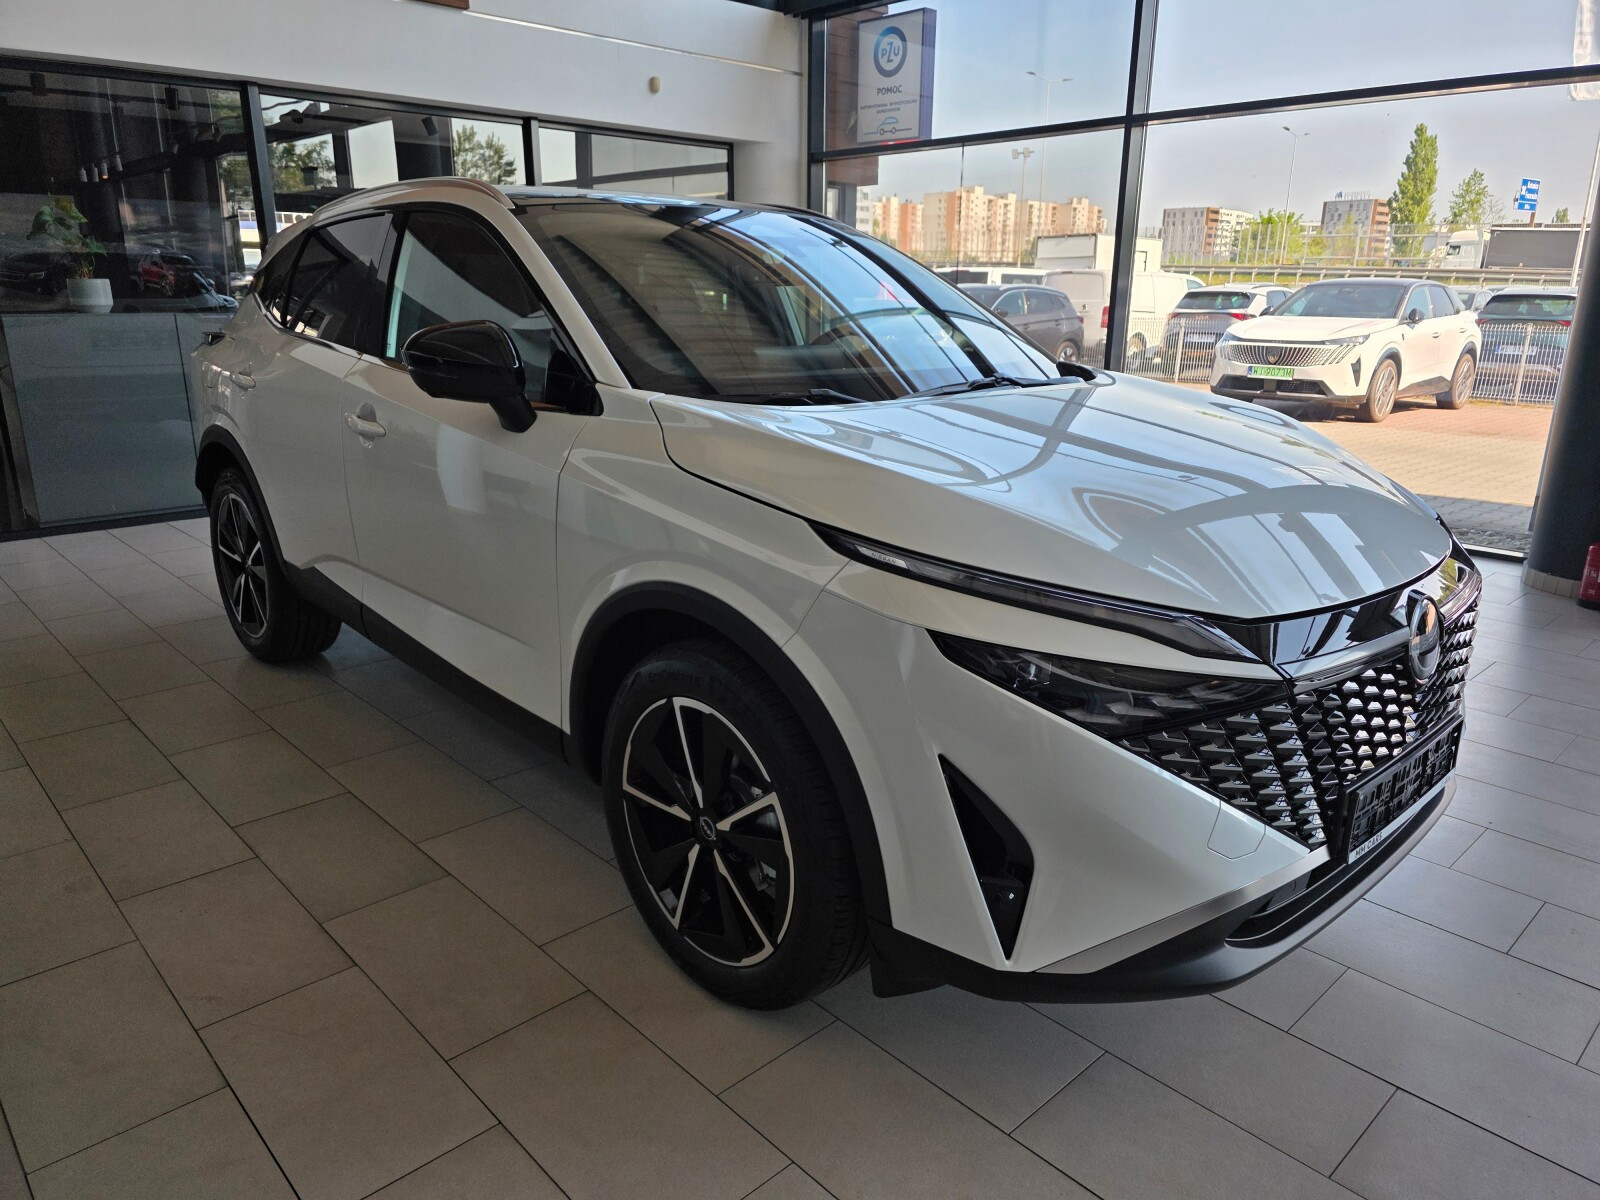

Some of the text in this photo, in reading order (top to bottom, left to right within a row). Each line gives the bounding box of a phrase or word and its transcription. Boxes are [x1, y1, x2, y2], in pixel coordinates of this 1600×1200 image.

[881, 42, 900, 63] PZU
[877, 85, 902, 96] POMOC
[871, 552, 897, 565] NISSAN
[1367, 832, 1383, 849] CARS
